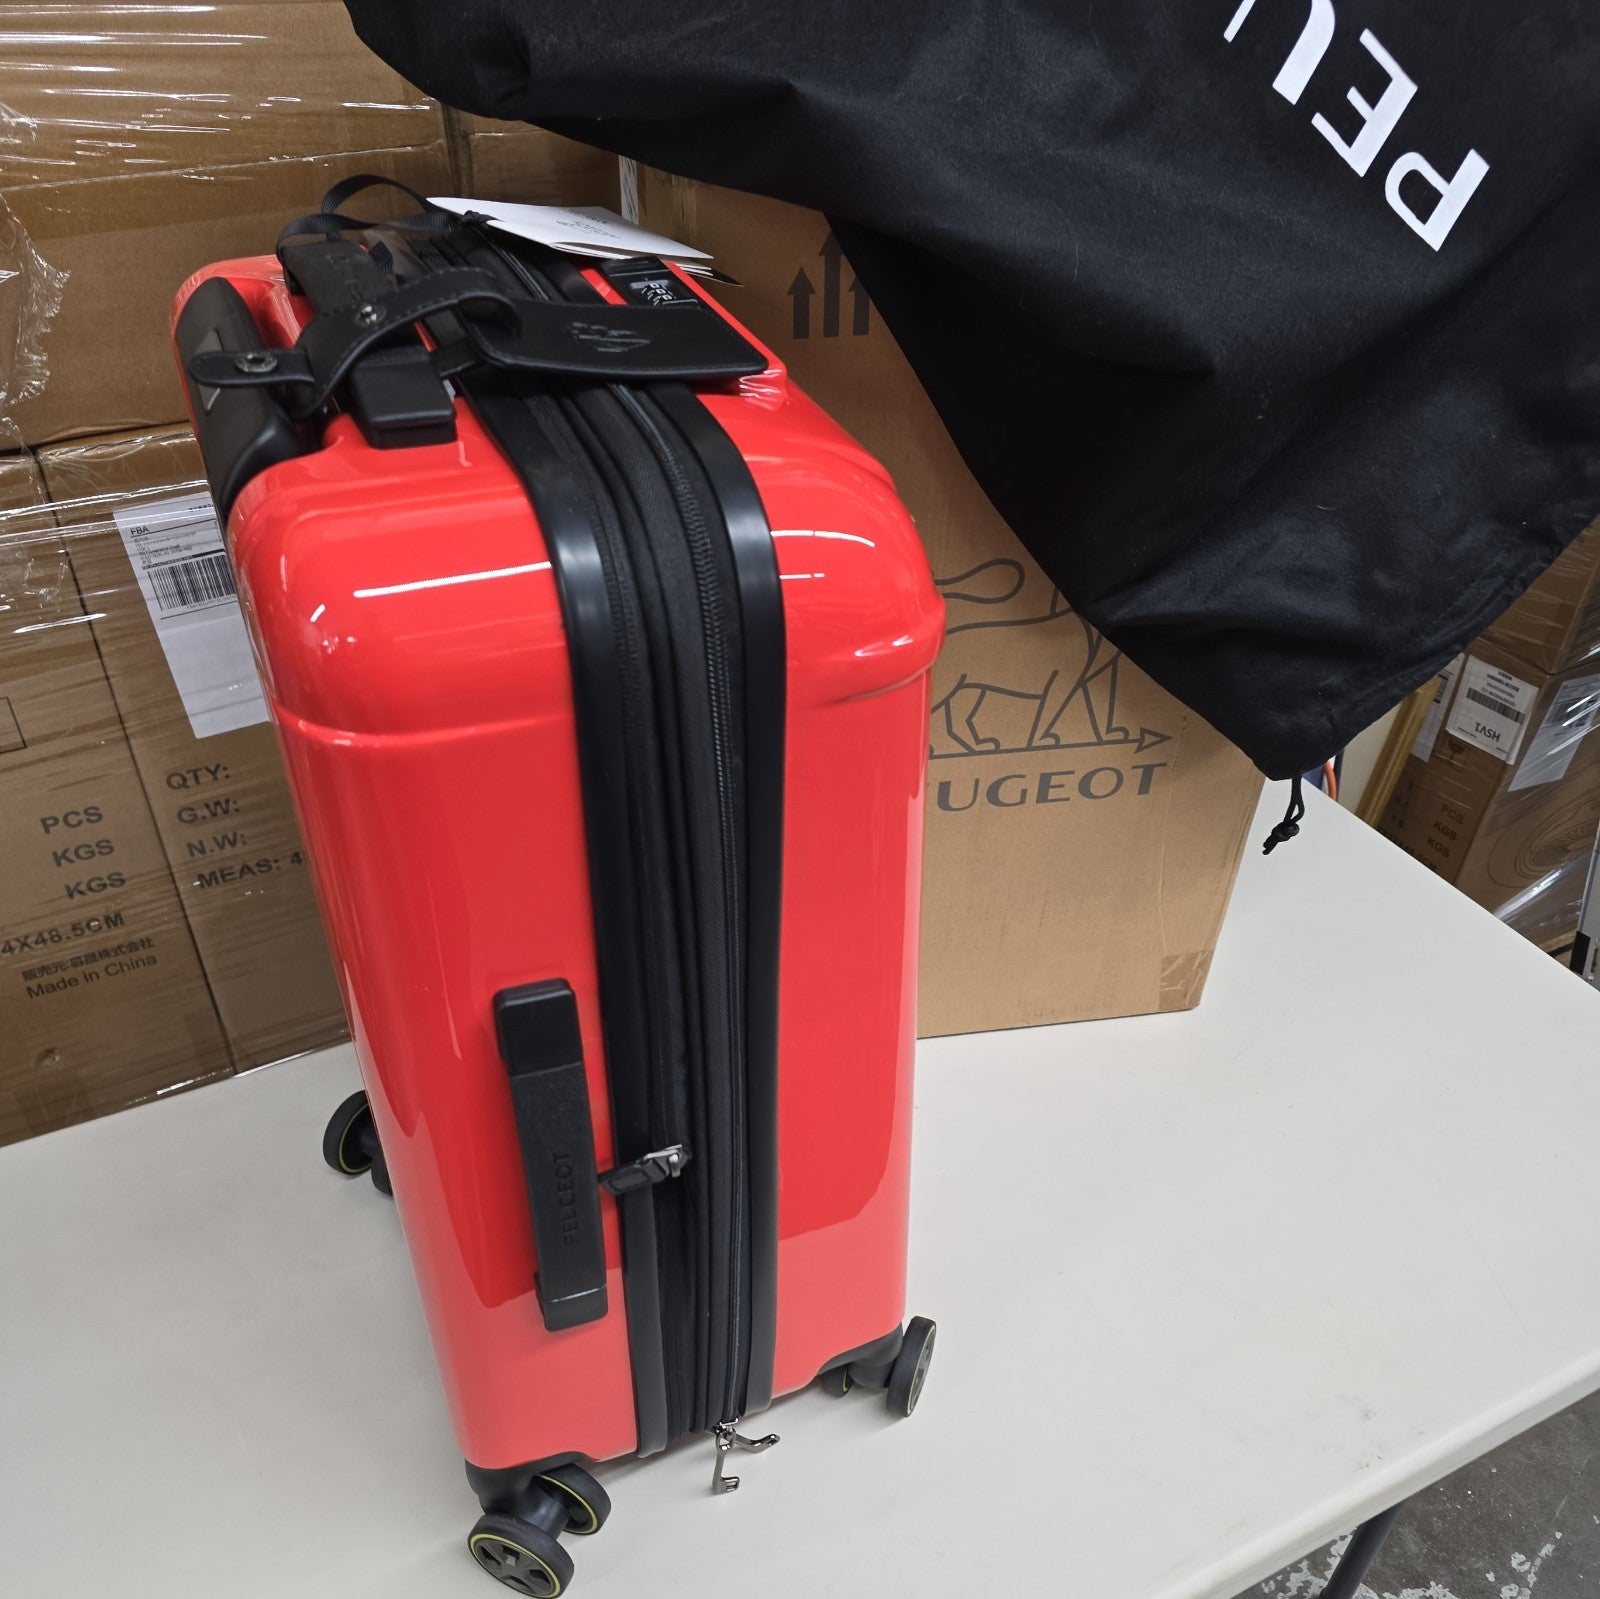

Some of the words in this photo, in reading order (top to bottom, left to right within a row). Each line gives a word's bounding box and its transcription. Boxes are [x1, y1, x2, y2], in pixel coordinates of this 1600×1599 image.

[130, 525, 150, 536] FBA
[1475, 722, 1501, 742] HSV1
[166, 764, 230, 790] QTY:
[936, 762, 1167, 812] UGEOT
[40, 806, 103, 834] PCS
[177, 798, 240, 824] G.W:
[1441, 803, 1464, 824] PCS
[1433, 820, 1458, 840] KGS
[51, 839, 115, 867] KGS
[186, 832, 247, 857] N.W:
[1427, 836, 1450, 858] KGS
[64, 872, 126, 899] KGS
[196, 858, 281, 889] MEAS:
[26, 974, 79, 999] Made
[84, 970, 100, 983] in
[104, 955, 158, 977] China
